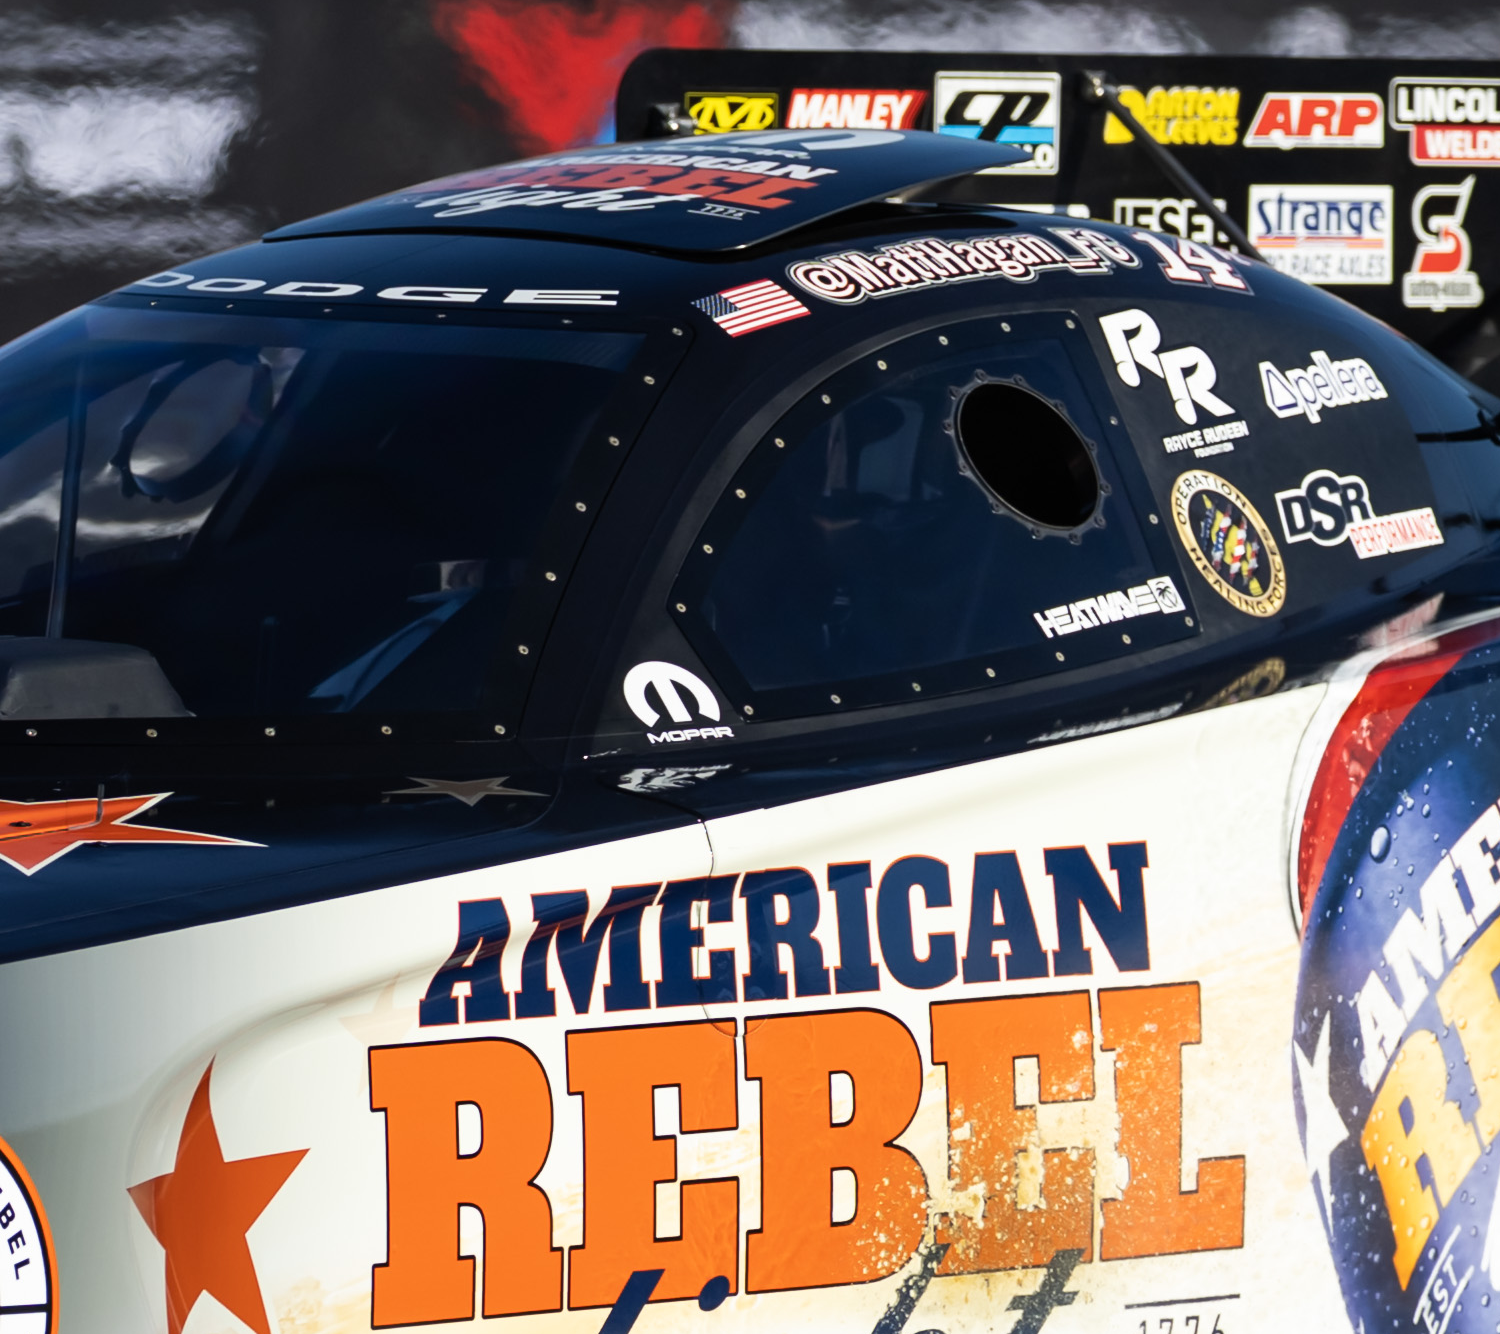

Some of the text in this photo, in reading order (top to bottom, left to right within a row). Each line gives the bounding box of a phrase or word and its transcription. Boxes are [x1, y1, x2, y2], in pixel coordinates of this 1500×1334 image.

[789, 92, 915, 129] MANLEY
[1251, 99, 1379, 137] ARP
[405, 165, 820, 211] REBEL
[414, 182, 705, 219] light
[1130, 229, 1250, 291] 14
[142, 270, 620, 306] DODGE
[1174, 473, 1248, 527] OPERATION
[1280, 475, 1371, 541] DSR
[1349, 512, 1440, 555] PERFORMANCE
[1190, 546, 1269, 615] HEALING
[646, 725, 735, 745] MOPAR
[417, 840, 1151, 1027] AMERICAN
[367, 981, 1248, 1331] REBEL
